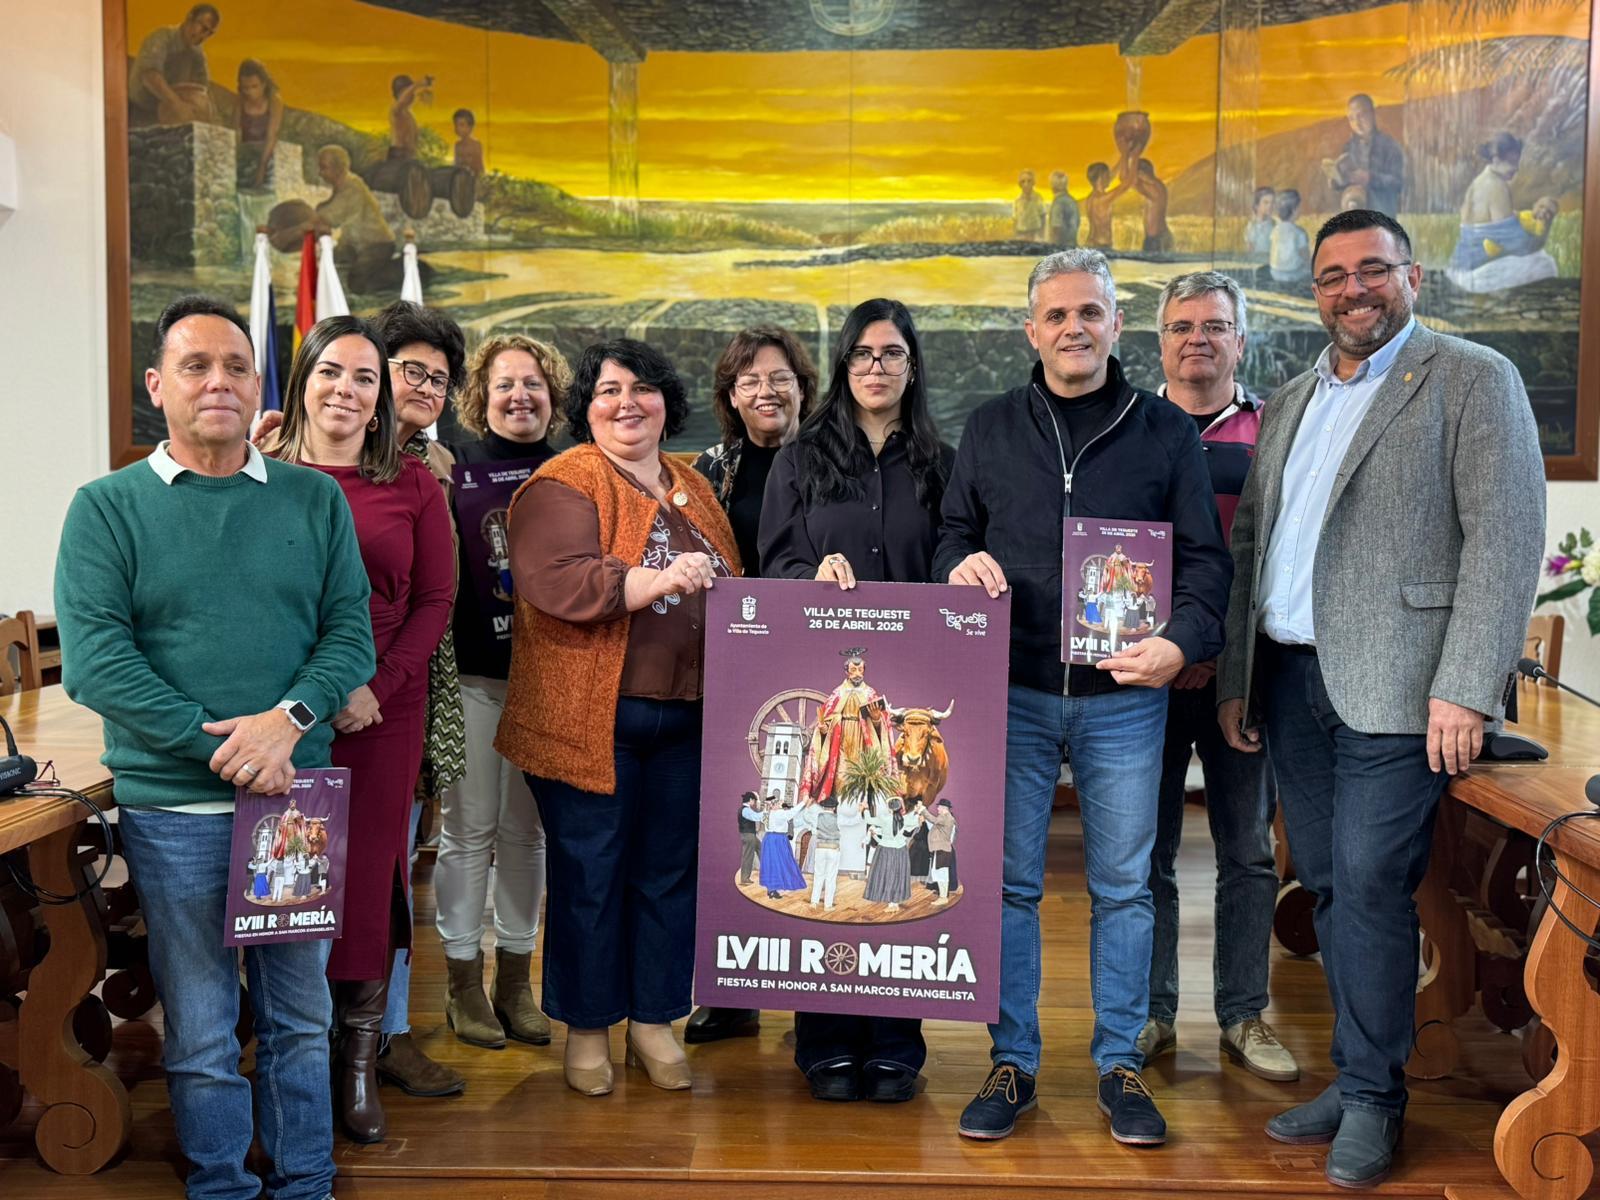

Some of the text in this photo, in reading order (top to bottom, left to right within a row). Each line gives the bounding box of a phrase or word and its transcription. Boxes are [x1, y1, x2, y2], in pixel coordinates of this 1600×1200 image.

[804, 607, 911, 620] VILLA DE TEGUESTE
[809, 619, 904, 632] 26 DE ABRIL 2026
[234, 915, 264, 931] LVIII
[716, 935, 791, 972] LVIII
[717, 977, 976, 1001] FIESTAS EN HONOR A SAN MARCOS EVANGELISTA
